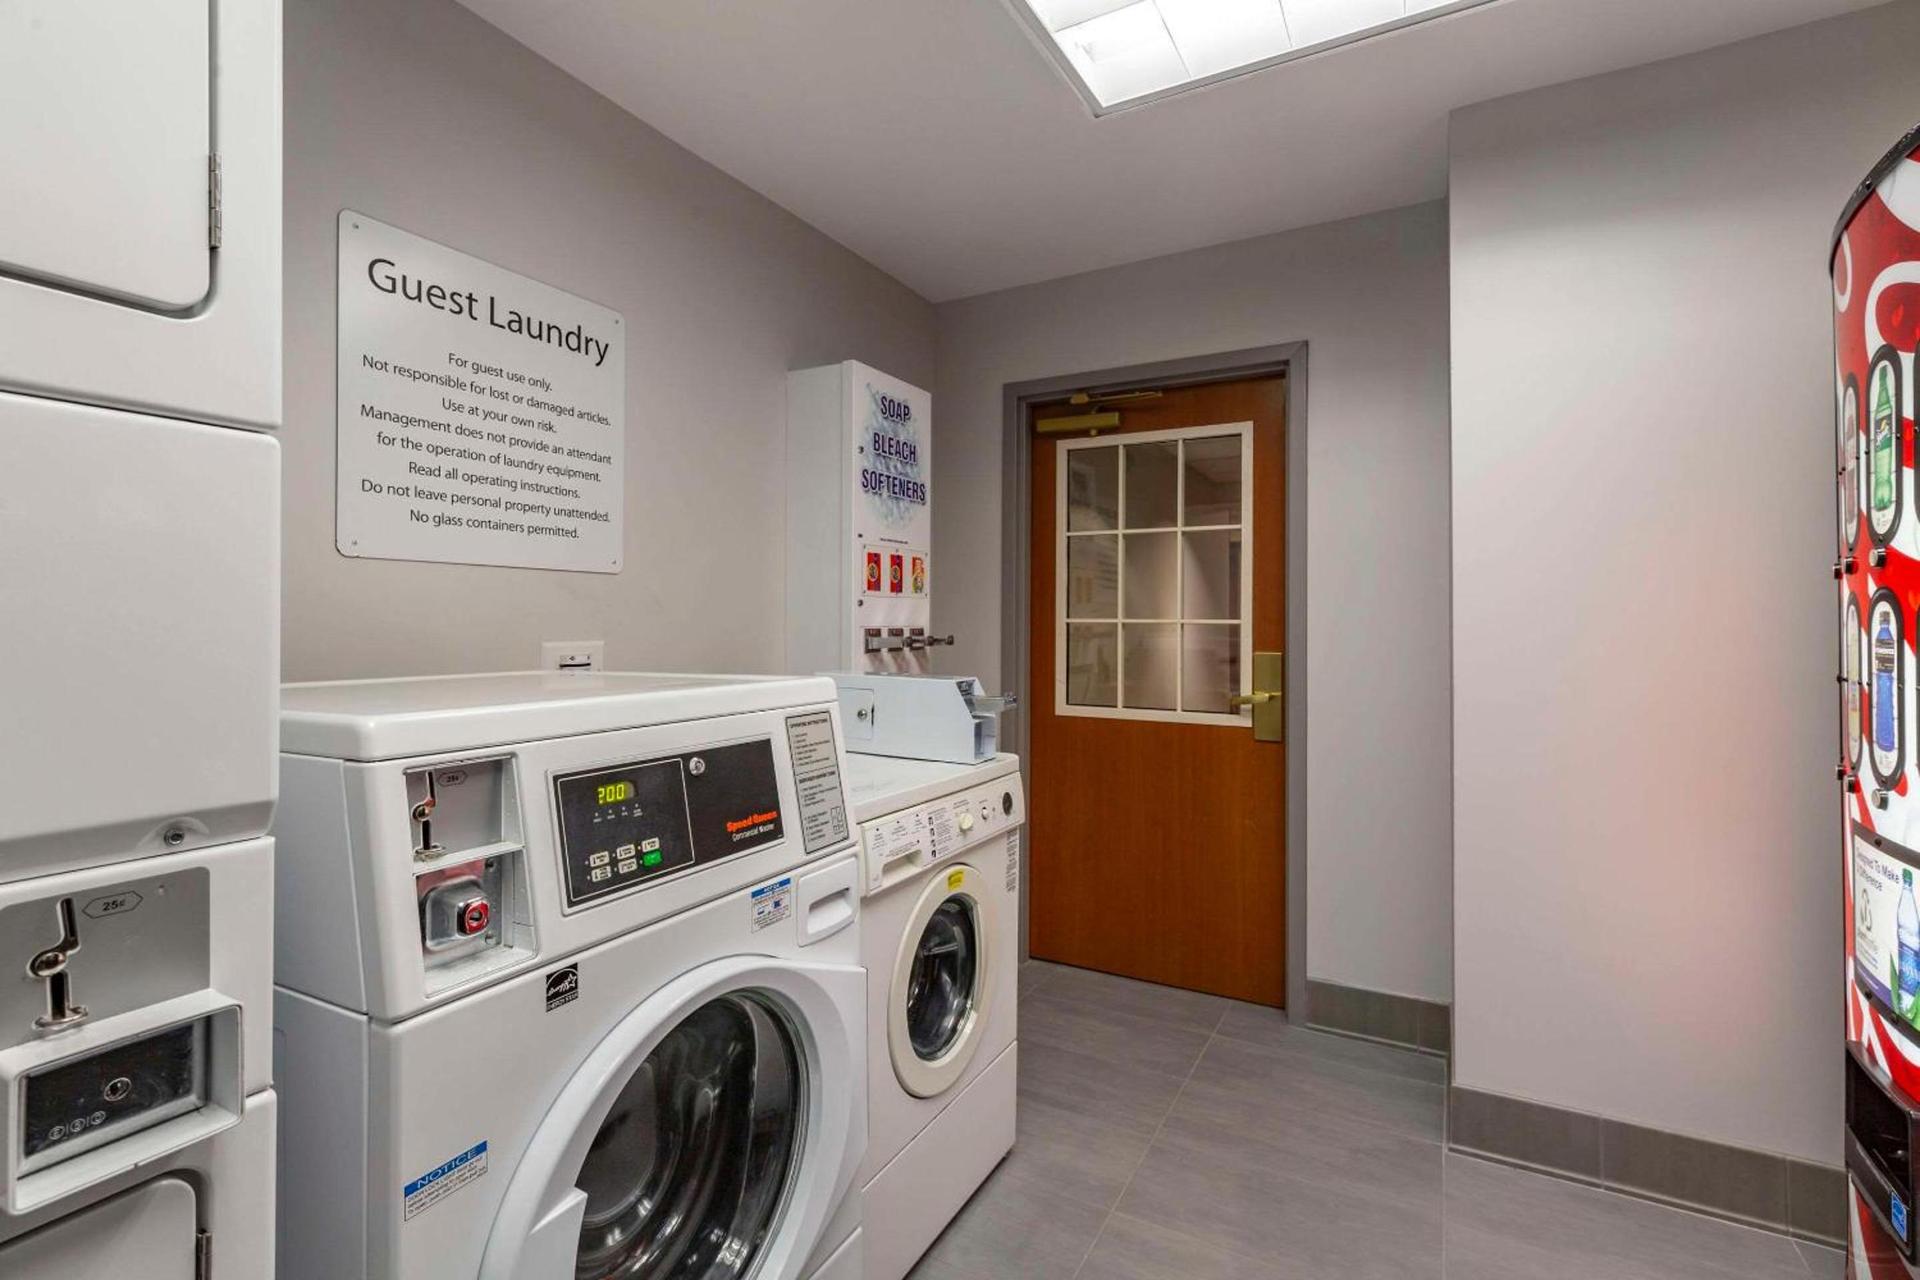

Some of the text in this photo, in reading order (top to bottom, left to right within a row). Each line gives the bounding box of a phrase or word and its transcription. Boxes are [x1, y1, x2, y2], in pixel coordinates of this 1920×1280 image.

[368, 258, 610, 367] Guest Laundry
[361, 354, 611, 426] Not responsible for lost or damaged articles.
[448, 352, 552, 392] For guest use only.
[442, 397, 557, 434] Use at your own risk.
[880, 396, 910, 423] SOAP
[360, 404, 612, 465] Management does not provide an attendant
[873, 432, 916, 463] BLEACH
[376, 431, 602, 482] for the operation of laundry equipment.
[362, 478, 610, 522] Do not leave personal property unattended.
[409, 461, 580, 500] Read all operating instructions.
[862, 469, 926, 502] SOFTENERS
[410, 509, 580, 541] No glass containers permitted.
[416, 1149, 477, 1189] NOTICE
